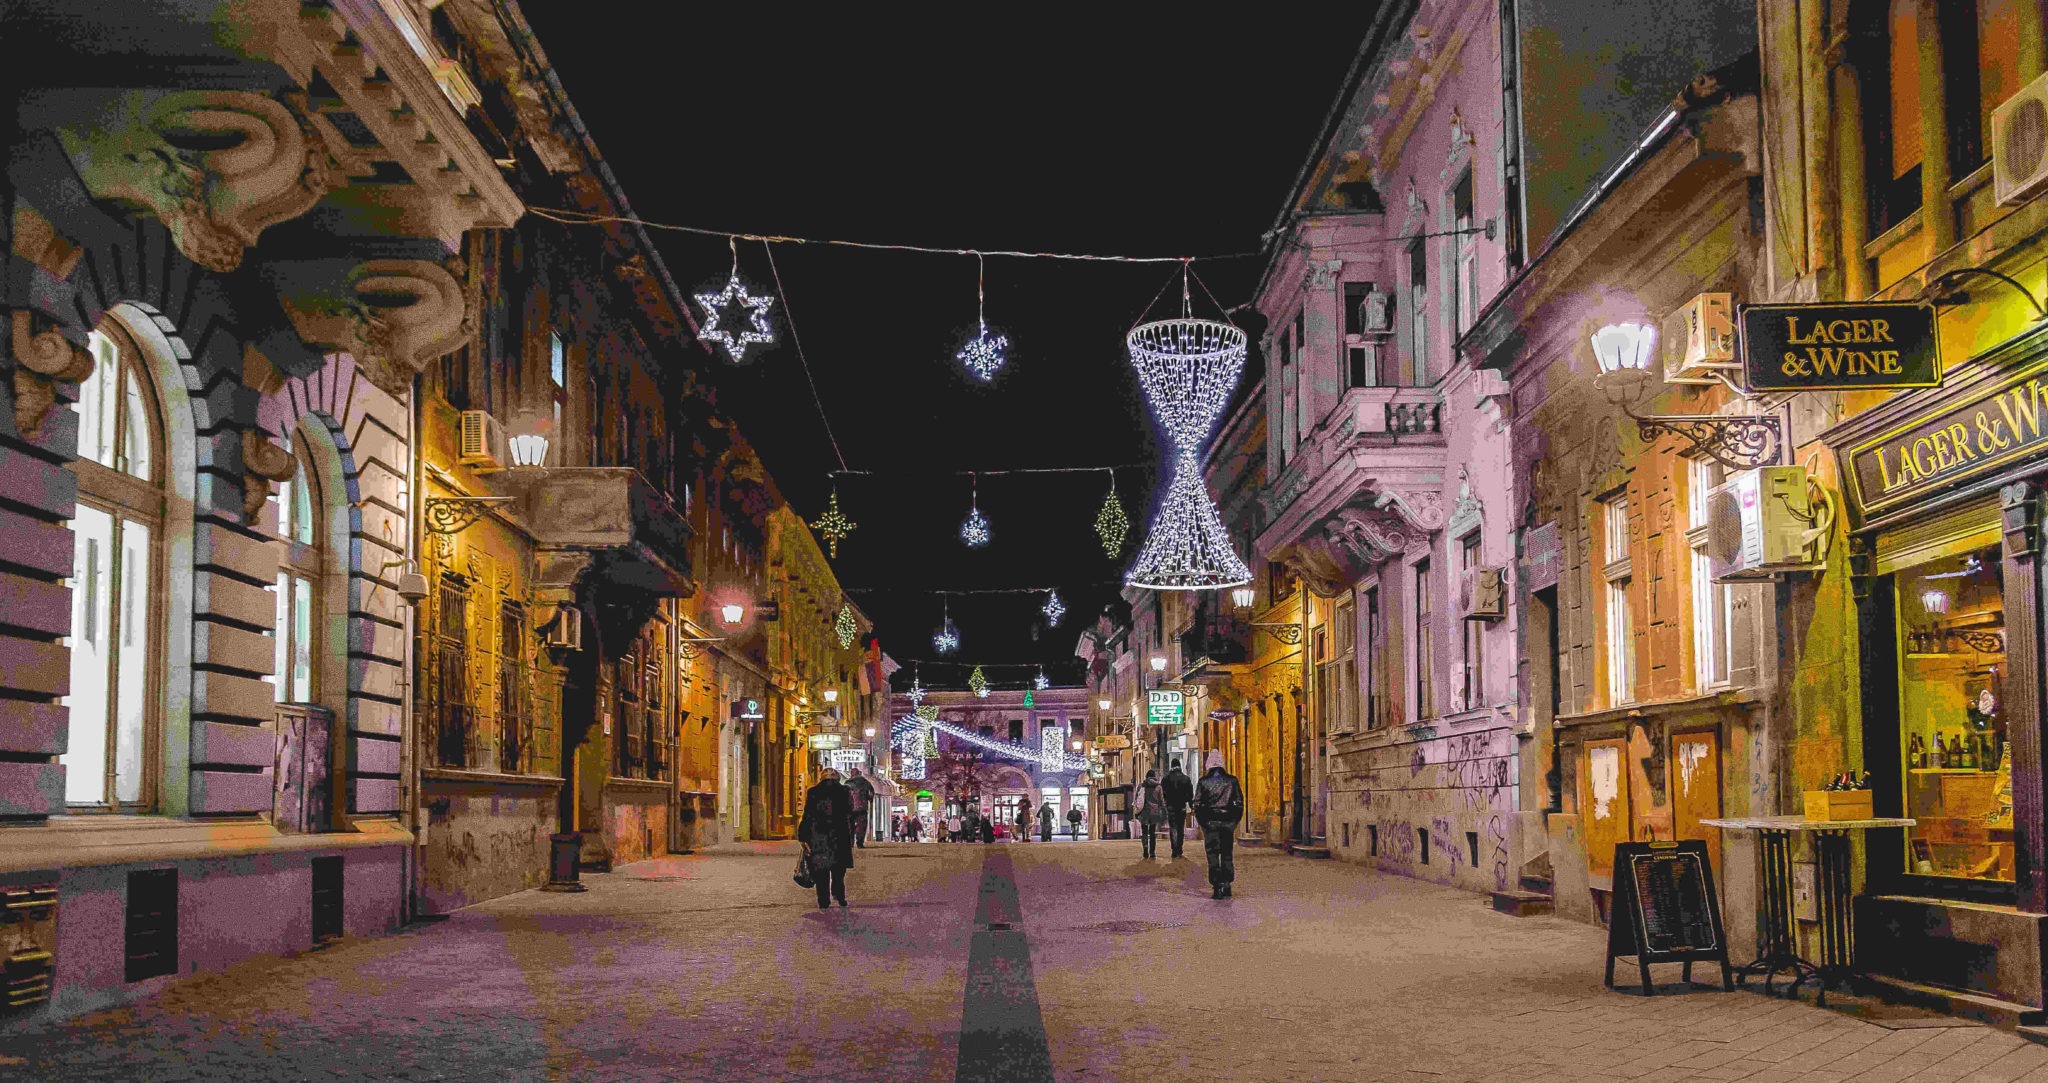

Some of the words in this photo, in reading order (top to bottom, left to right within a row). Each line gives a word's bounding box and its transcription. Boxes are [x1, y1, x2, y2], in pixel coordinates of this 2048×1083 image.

[1785, 316, 1894, 345] LAGER
[1874, 423, 1978, 493] LAGER
[1151, 692, 1161, 703] D
[1162, 694, 1168, 703] &
[1170, 692, 1180, 703] D
